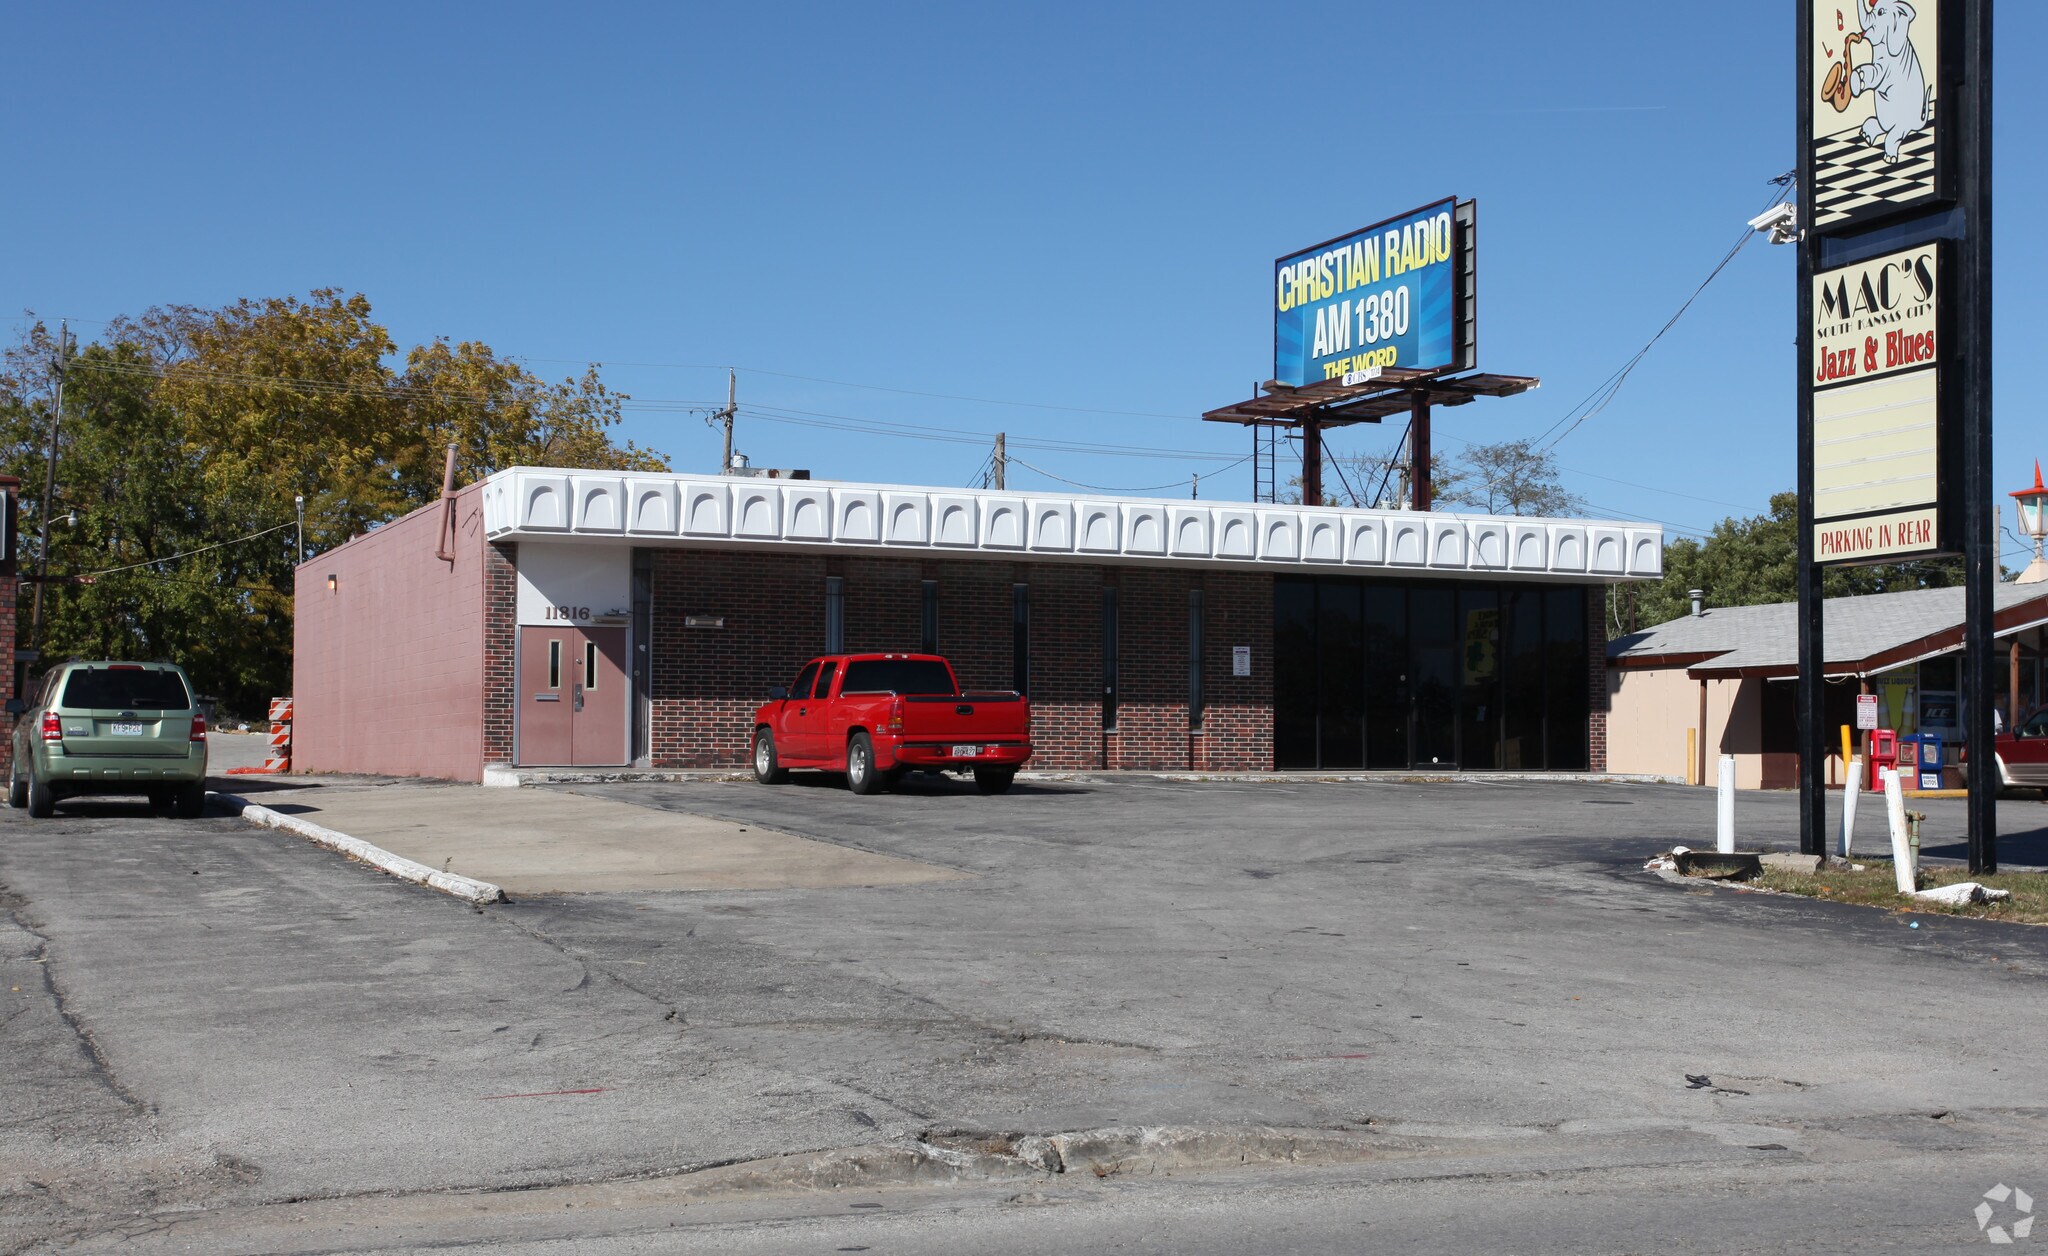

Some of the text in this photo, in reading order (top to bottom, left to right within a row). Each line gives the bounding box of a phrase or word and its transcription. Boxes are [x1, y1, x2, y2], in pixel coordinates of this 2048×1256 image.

[1278, 211, 1452, 313] CHRISTIAN RADIO
[1818, 254, 1934, 324] MAC'S
[1312, 285, 1409, 359] AM 1380
[1817, 303, 1933, 339] SOUTH KANSAS CITY
[1323, 346, 1397, 381] THE WORD
[1816, 328, 1935, 382] Jazz & Blues
[1821, 519, 1931, 555] PARKING IN REAR
[545, 606, 590, 621] 11816
[1926, 707, 1949, 718] ICE
